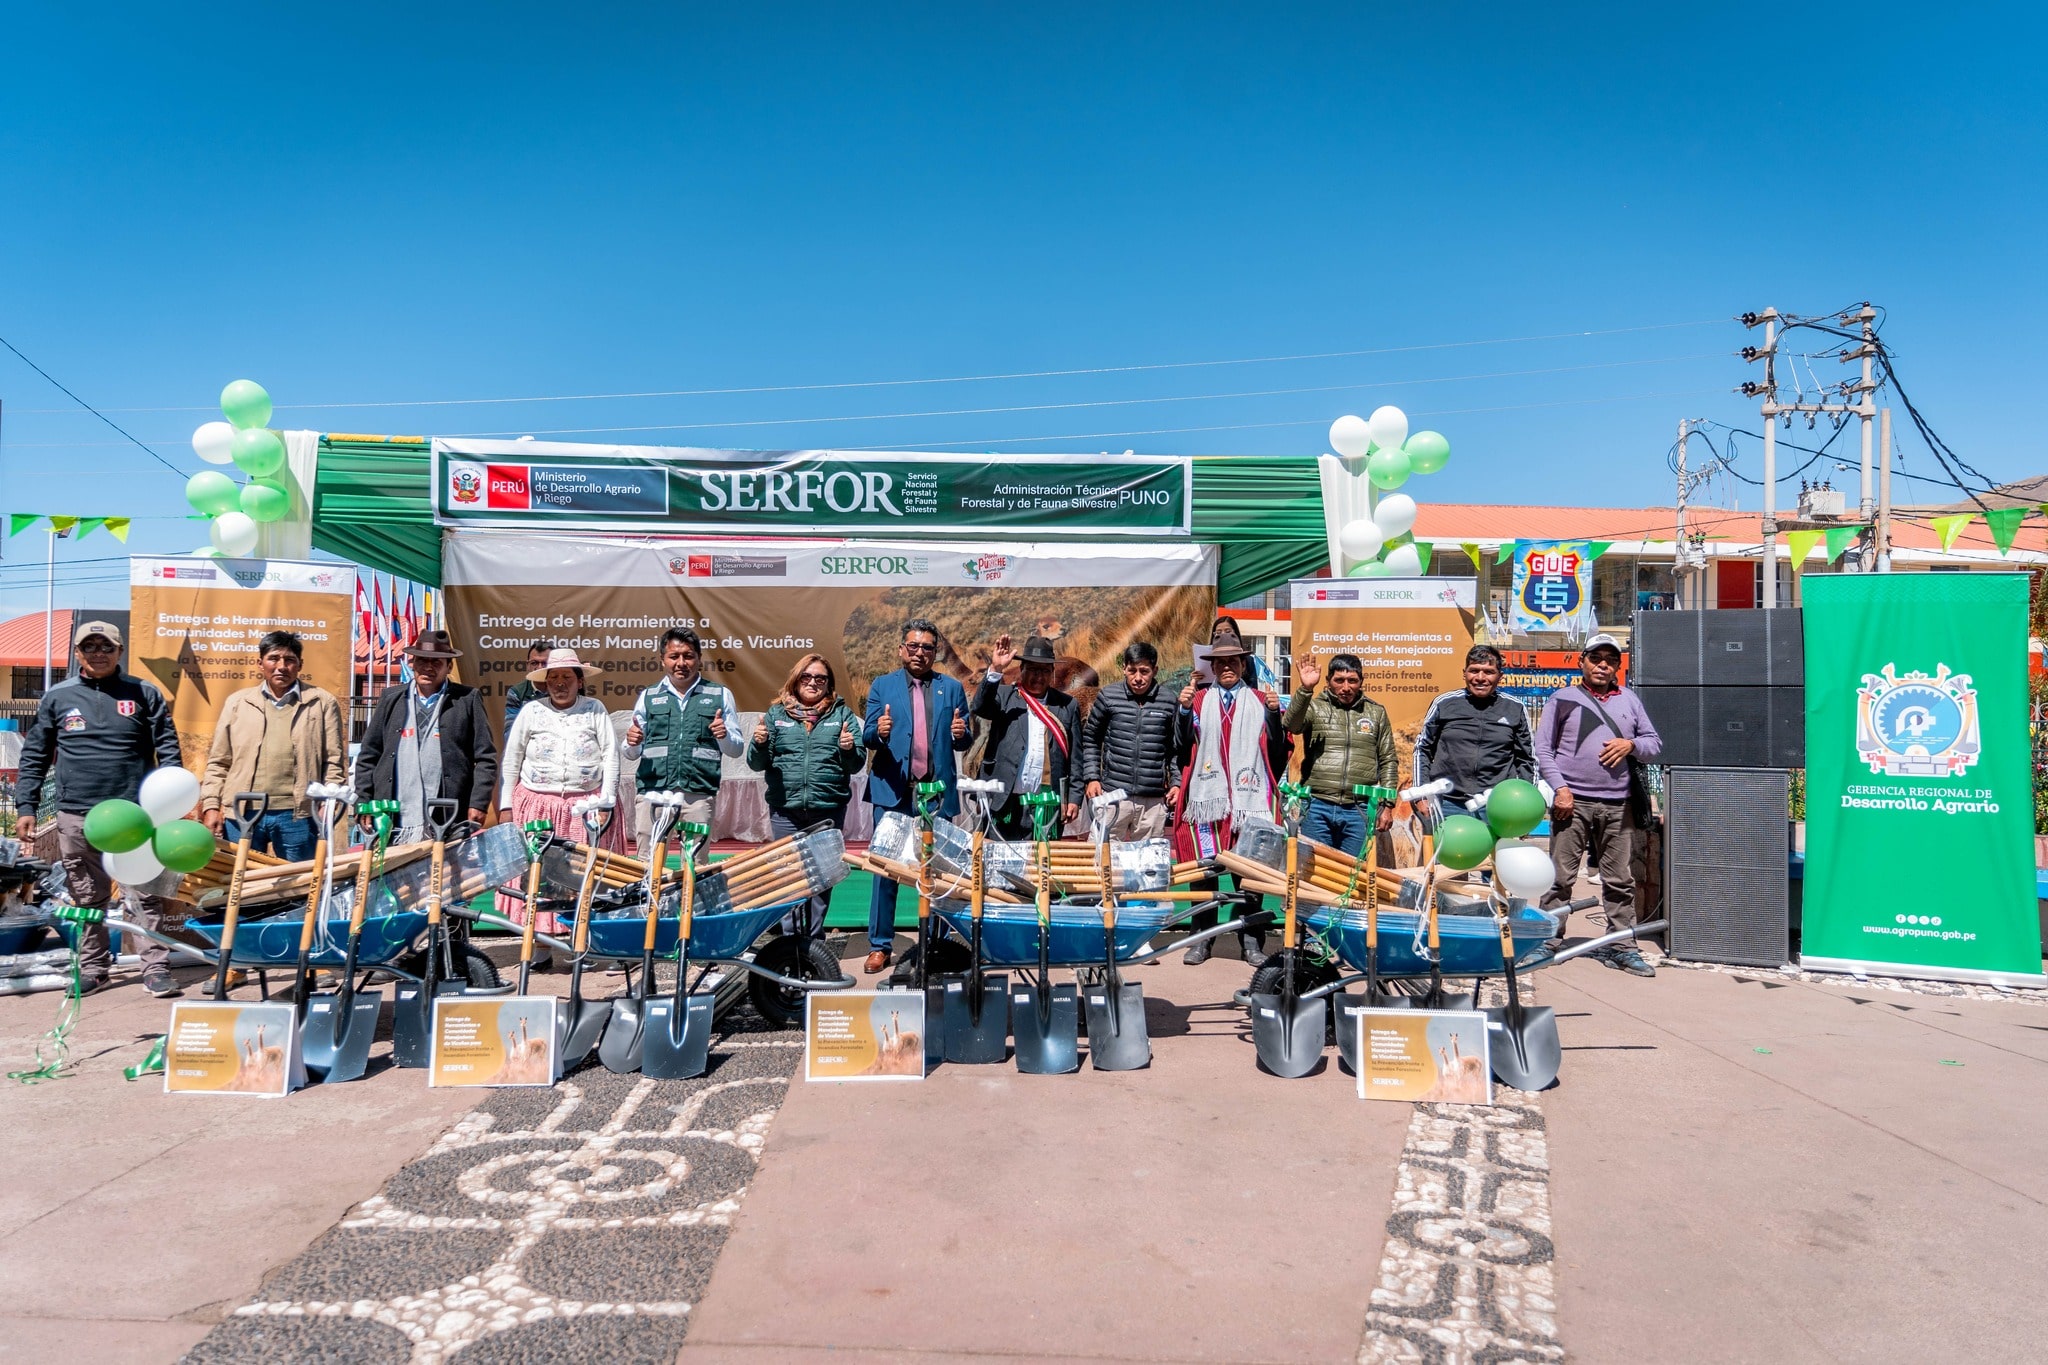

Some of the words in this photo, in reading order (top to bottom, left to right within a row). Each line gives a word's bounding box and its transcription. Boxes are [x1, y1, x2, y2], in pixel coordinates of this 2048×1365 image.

[535, 471, 587, 482] Ministerio
[907, 472, 938, 480] Servicio
[491, 479, 525, 494] PERÚ
[535, 482, 548, 492] de
[550, 483, 602, 494] Desarrollo
[604, 484, 641, 496] Agrario
[993, 484, 1073, 495] Administración
[1075, 484, 1118, 495] Técnica
[700, 470, 904, 516] SERFOR
[932, 490, 938, 498] y
[1119, 490, 1170, 505] PUNO
[535, 496, 542, 505] y
[544, 494, 572, 506] Riego
[903, 497, 914, 505] de
[914, 497, 938, 505] Fauna
[961, 497, 1005, 508] Forestal
[1007, 500, 1015, 511] y
[1017, 498, 1031, 509] de
[1034, 498, 1068, 509] Fauna
[1071, 498, 1117, 509] Silvestre
[905, 505, 938, 513] Silvestre
[821, 556, 913, 576] SERFOR
[234, 570, 282, 582] SERFOR
[1373, 590, 1414, 600] SERFOR
[158, 613, 210, 626] Entrega
[213, 614, 229, 625] de
[232, 615, 315, 628] Herramientas
[317, 619, 327, 628] a
[479, 614, 547, 631] Entrega
[552, 614, 575, 628] de
[579, 614, 696, 629] Herramientas
[699, 617, 710, 629] a
[156, 627, 246, 639] Comunidades
[1313, 632, 1354, 644] Entrega
[1355, 632, 1369, 642] de
[1371, 632, 1442, 642] Herramientas
[1444, 634, 1452, 642] a
[190, 641, 208, 651] de
[211, 641, 260, 652] Vicuñas
[721, 635, 743, 649] de
[747, 635, 814, 649] Vicuñas
[1310, 645, 1383, 654] Comunidades
[1385, 645, 1454, 656] Manejadoras
[479, 659, 527, 676] para
[1397, 659, 1423, 668] para
[184, 670, 246, 680] Incendios
[1363, 670, 1399, 680] ención
[1401, 670, 1433, 680] frente
[1385, 683, 1440, 693] Forestales
[1847, 785, 1907, 796] GERENCIA
[1909, 787, 1973, 798] REGIONAL
[1974, 789, 1992, 799] DE
[1841, 795, 1928, 811] Desarrollo
[1931, 798, 2000, 815] Agrario
[229, 869, 242, 907] MAYARA
[1103, 865, 1112, 902] MAYARA
[1367, 871, 1376, 909] MAYARA
[162, 912, 193, 922] icuña
[1862, 924, 1977, 942] www.agropuno.gob.pe
